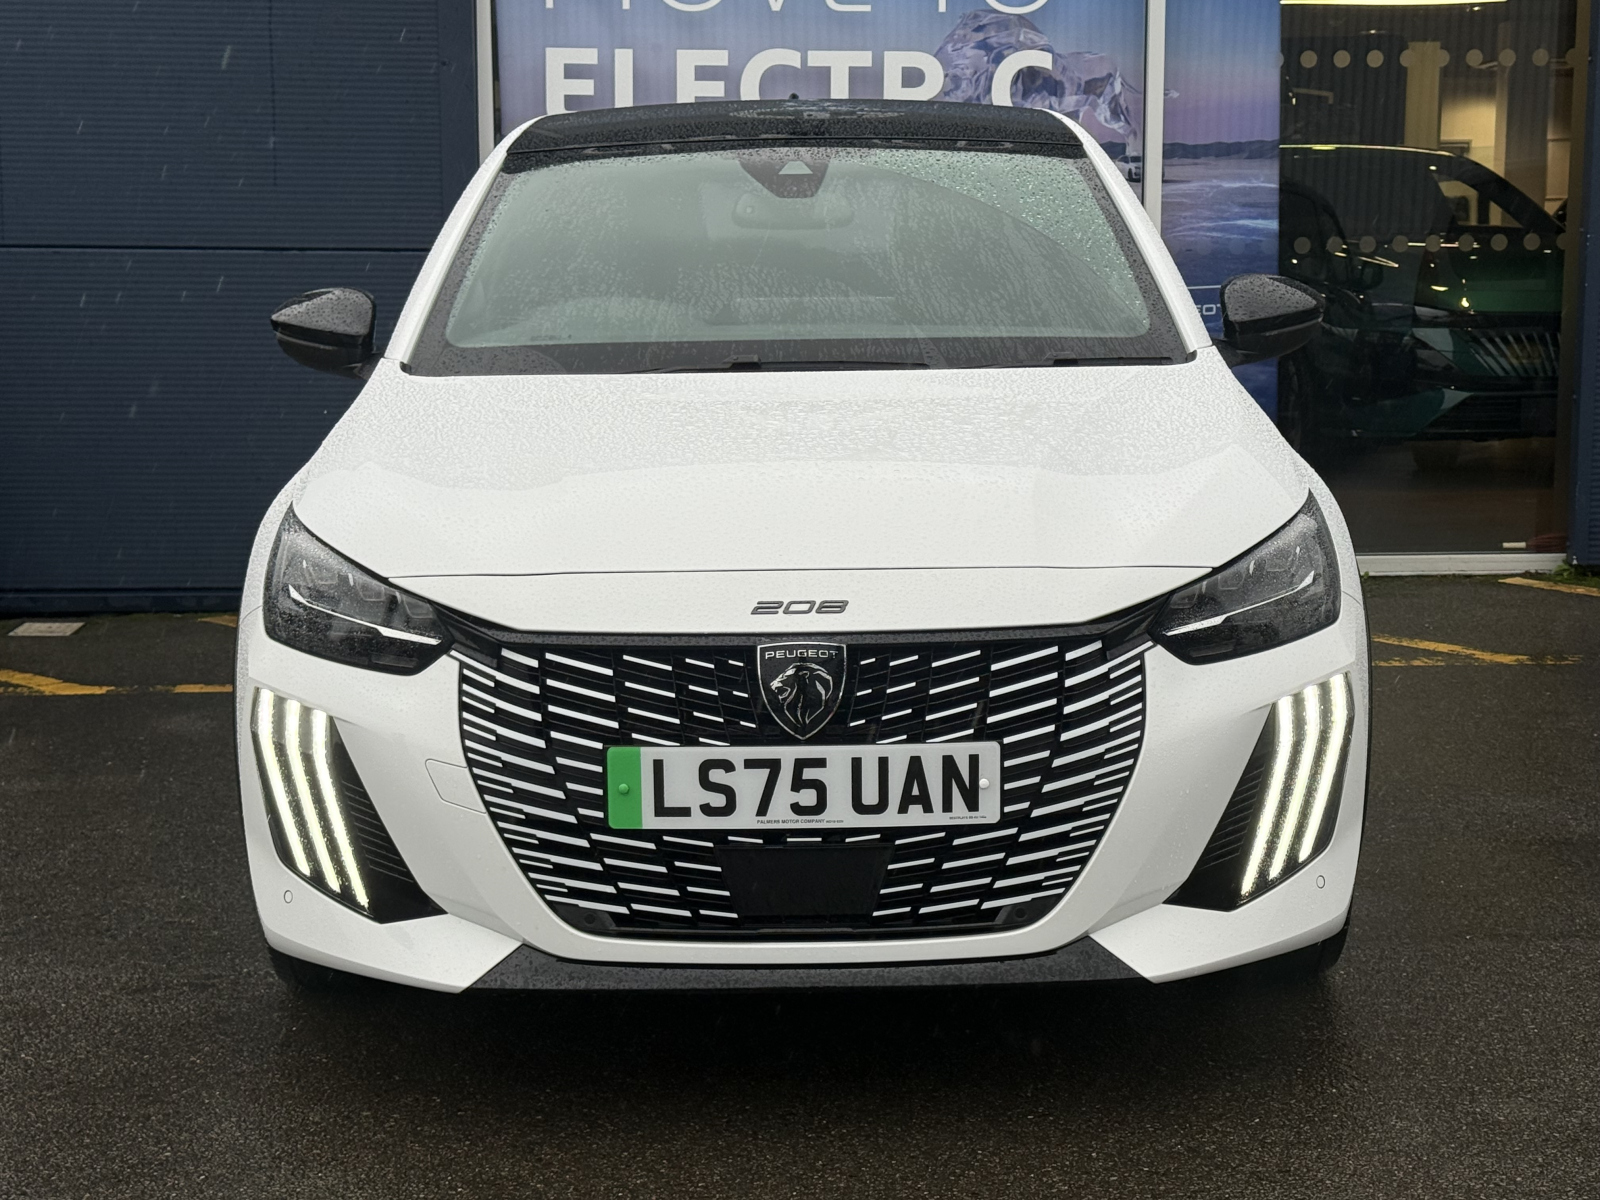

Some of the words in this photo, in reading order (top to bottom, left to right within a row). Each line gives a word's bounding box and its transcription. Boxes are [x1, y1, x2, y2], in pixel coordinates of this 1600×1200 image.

[545, 47, 1053, 115] ELECTRC
[750, 600, 849, 615] 208
[765, 649, 839, 660] PEUGEOT
[652, 758, 827, 817] LS75
[851, 754, 979, 815] UAN
